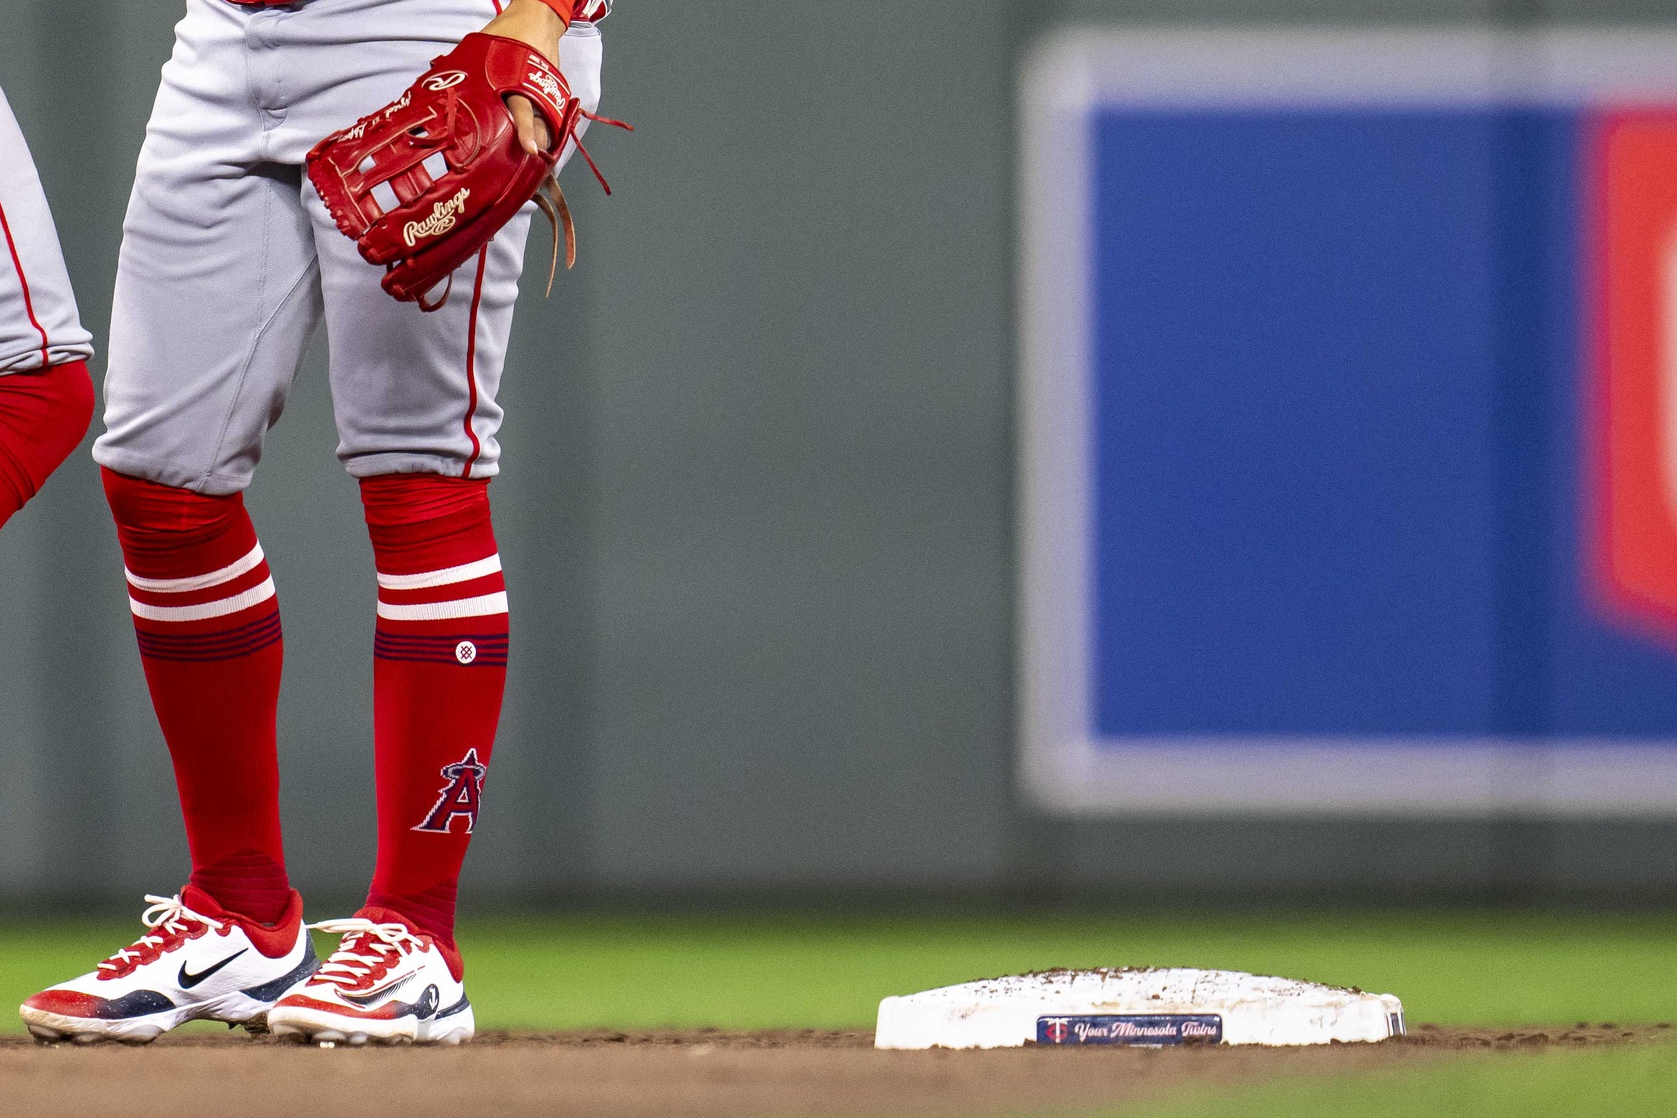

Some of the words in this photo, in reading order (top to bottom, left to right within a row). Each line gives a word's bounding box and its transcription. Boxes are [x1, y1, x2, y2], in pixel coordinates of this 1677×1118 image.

[403, 187, 471, 247] Rawlings
[1074, 1022, 1108, 1043] Your
[1110, 1021, 1177, 1040] Minnesota
[1181, 1021, 1217, 1037] Twins
